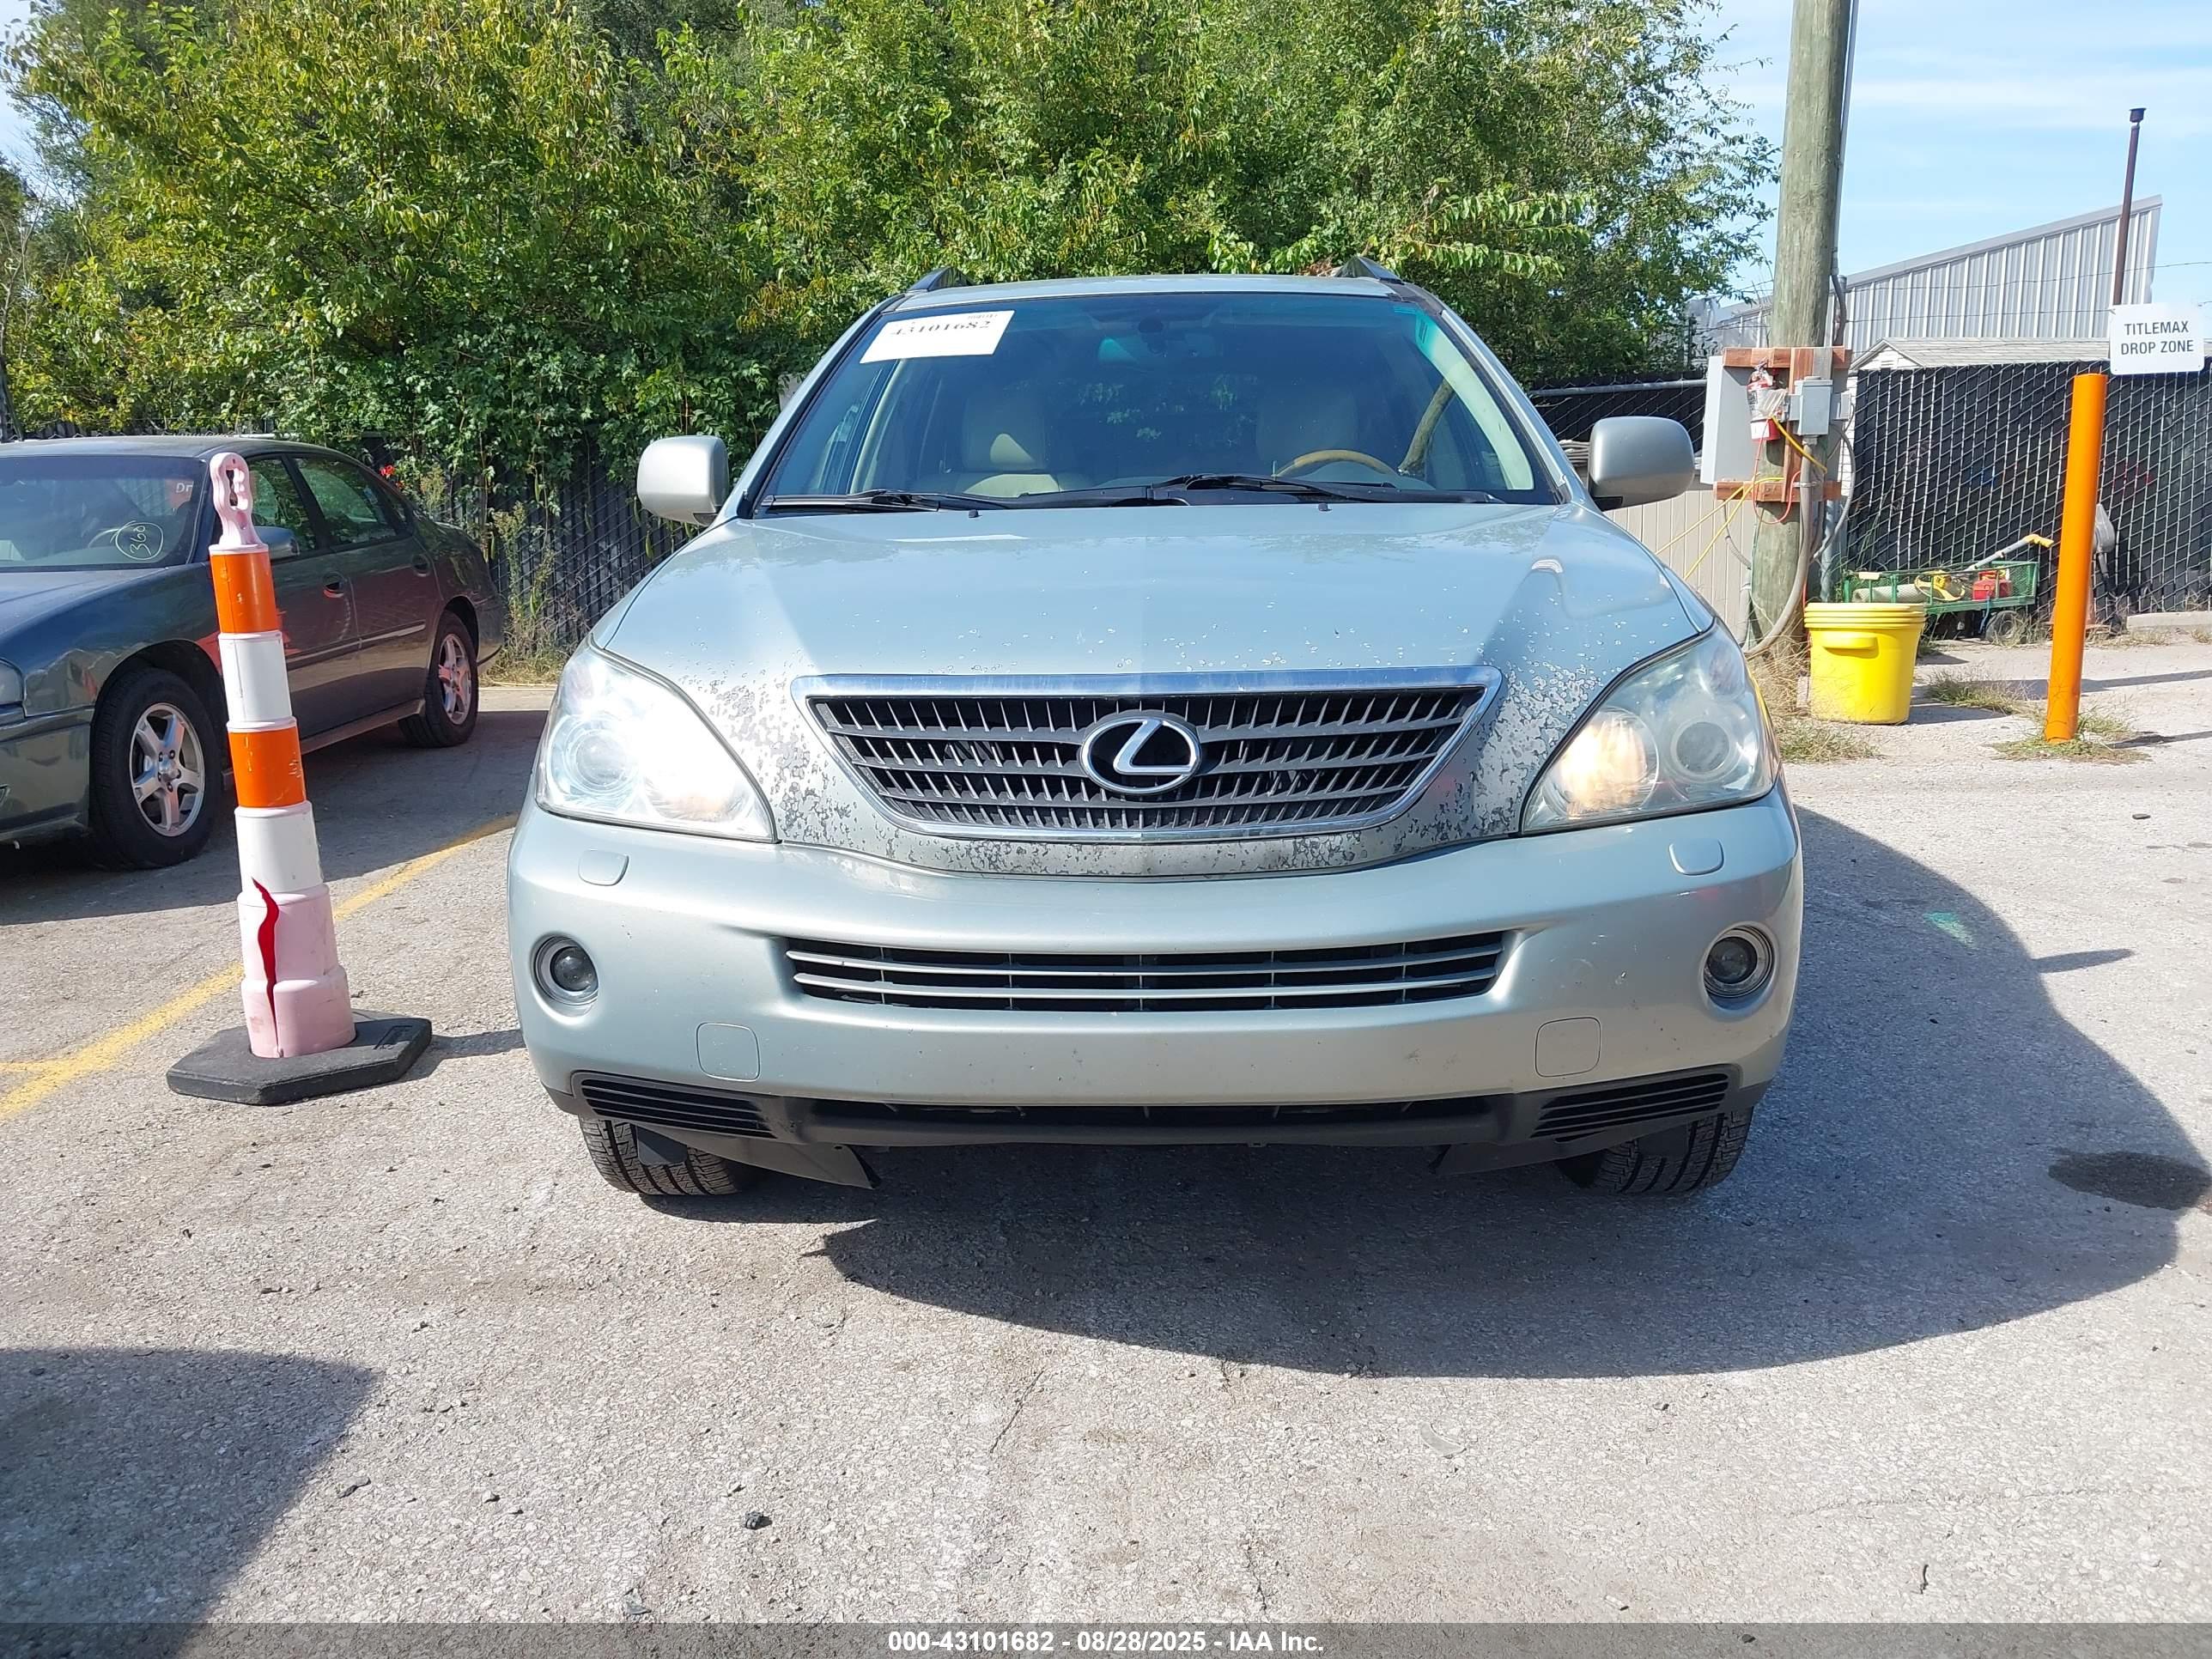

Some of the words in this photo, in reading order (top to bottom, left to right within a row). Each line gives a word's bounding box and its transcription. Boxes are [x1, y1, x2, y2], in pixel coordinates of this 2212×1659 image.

[2124, 320, 2190, 336] TITLEMAX
[2121, 342, 2156, 356] DROP
[2160, 339, 2195, 353] ZONE
